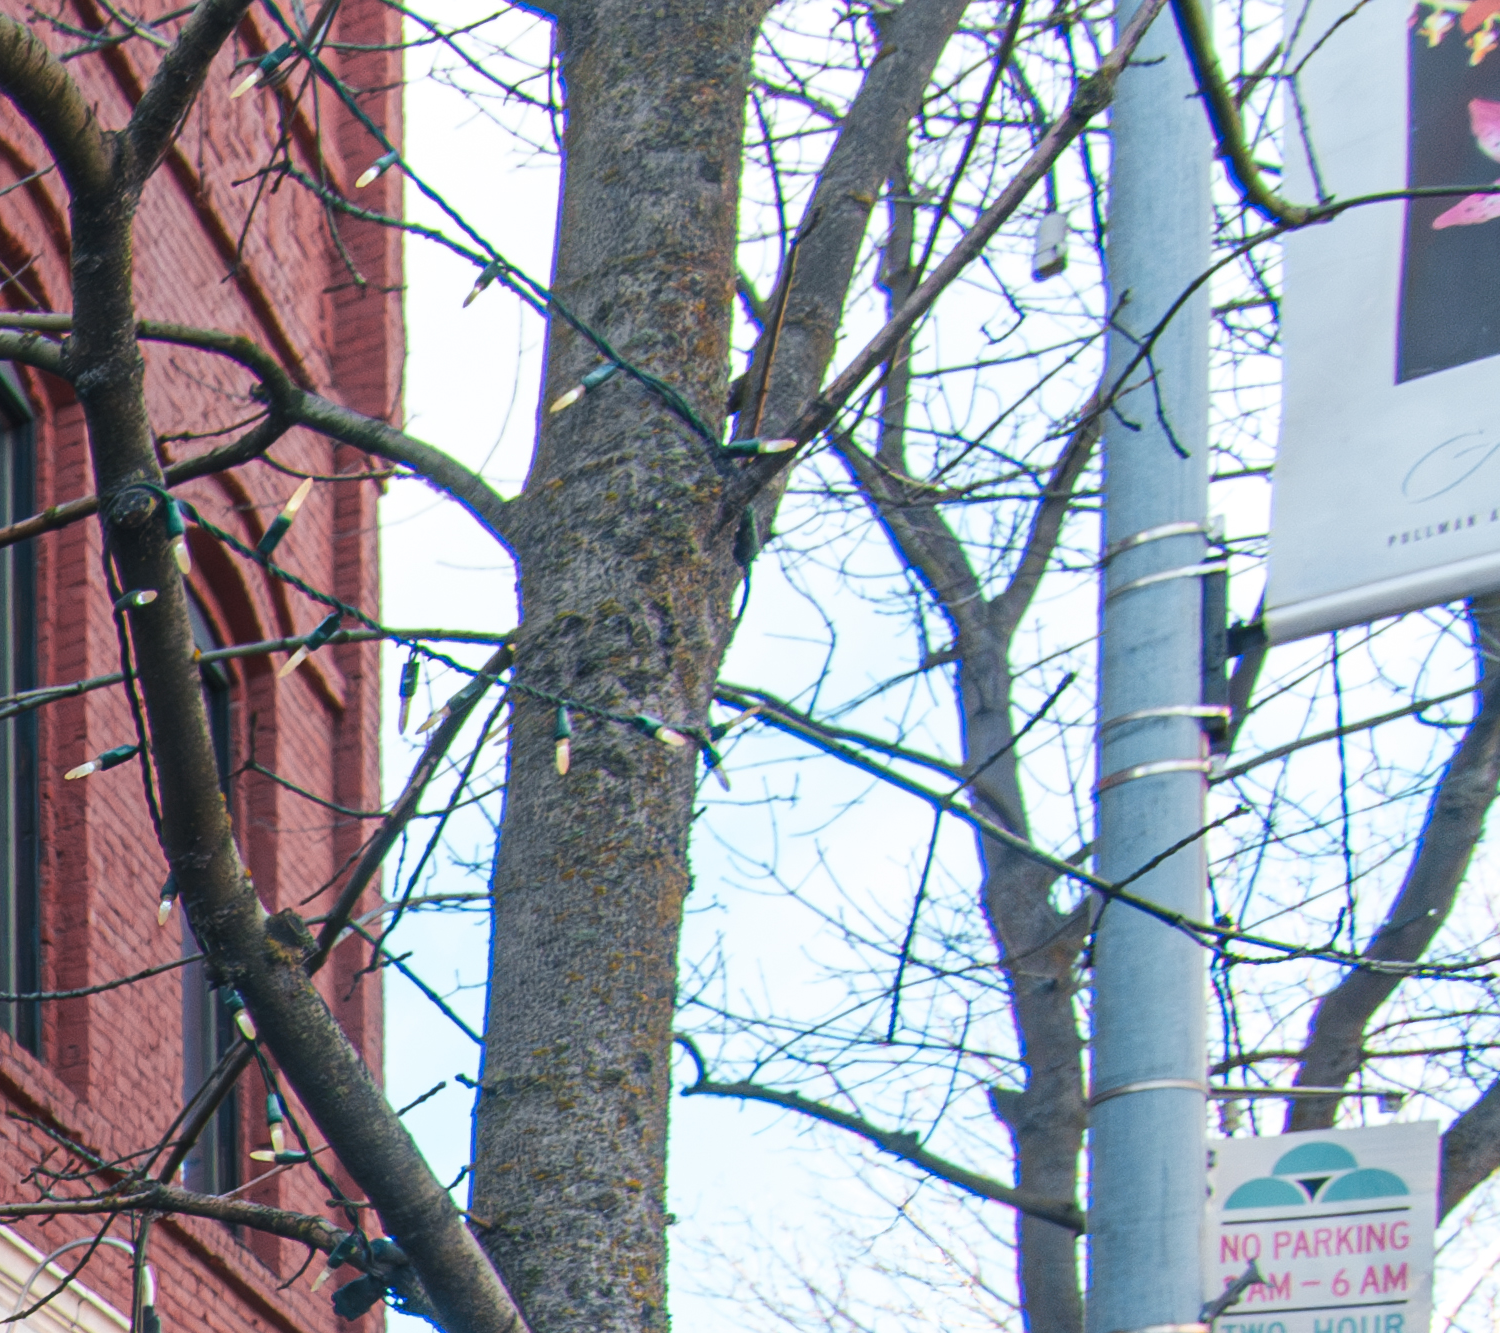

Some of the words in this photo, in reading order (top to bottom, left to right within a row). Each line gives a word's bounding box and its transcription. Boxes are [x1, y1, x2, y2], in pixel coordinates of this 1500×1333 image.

[1220, 1233, 1261, 1264] NO
[1274, 1222, 1411, 1260] PARKING
[1360, 1262, 1409, 1295] AM
